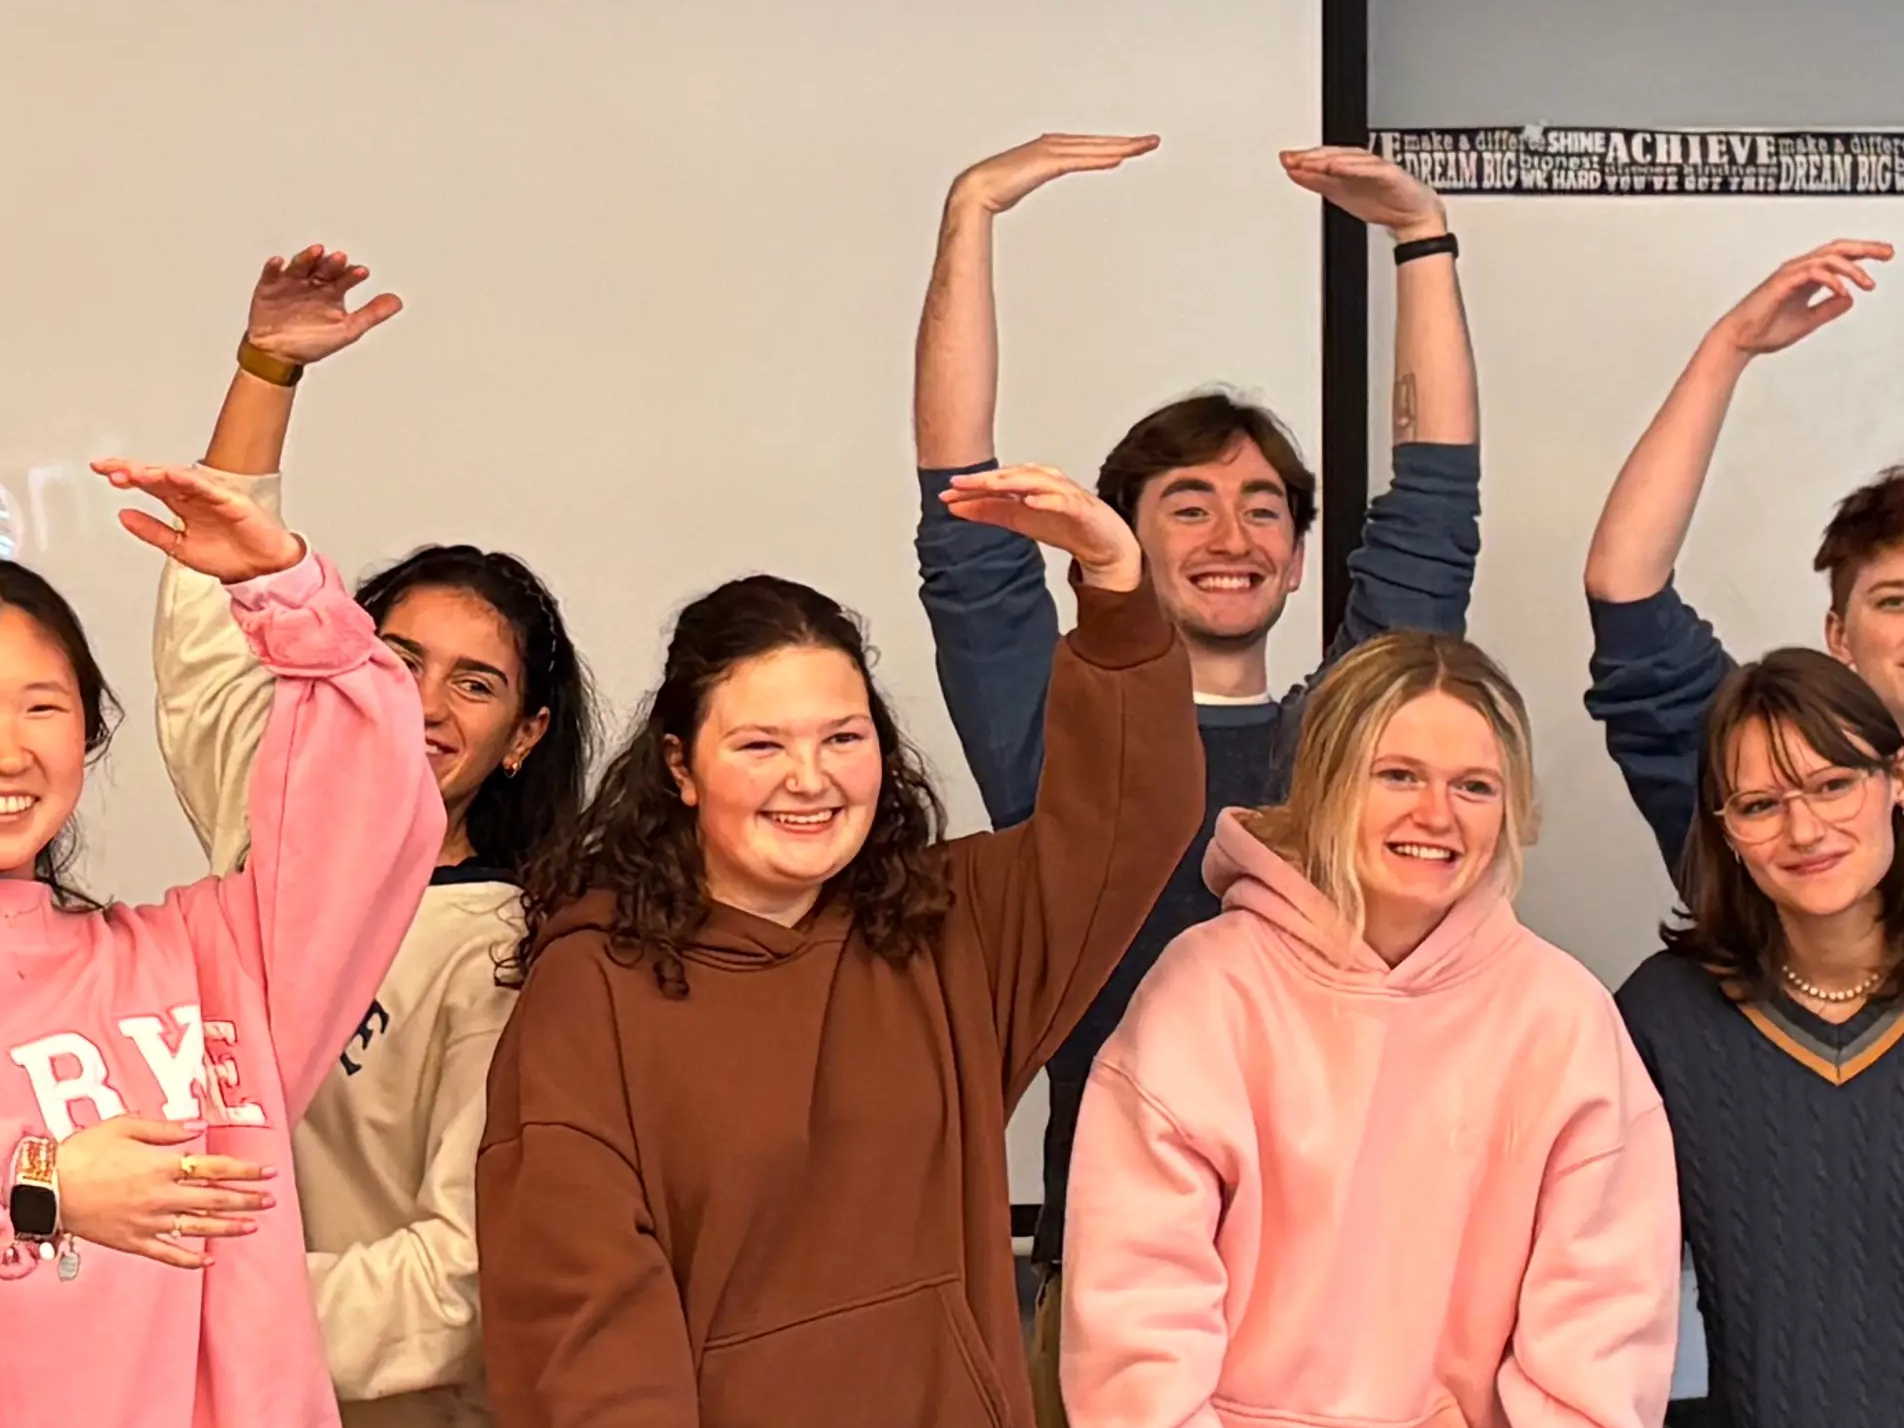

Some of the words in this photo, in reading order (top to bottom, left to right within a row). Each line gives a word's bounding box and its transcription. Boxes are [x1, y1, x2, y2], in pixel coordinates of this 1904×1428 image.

[1548, 131, 1606, 153] SHINE
[1605, 132, 1777, 165] ACHIEVE
[1404, 151, 1478, 189] DREAM
[1482, 151, 1516, 189] BIG
[1552, 170, 1601, 190] HARD
[1778, 154, 1852, 192] DREAM
[1856, 154, 1891, 192] BIG
